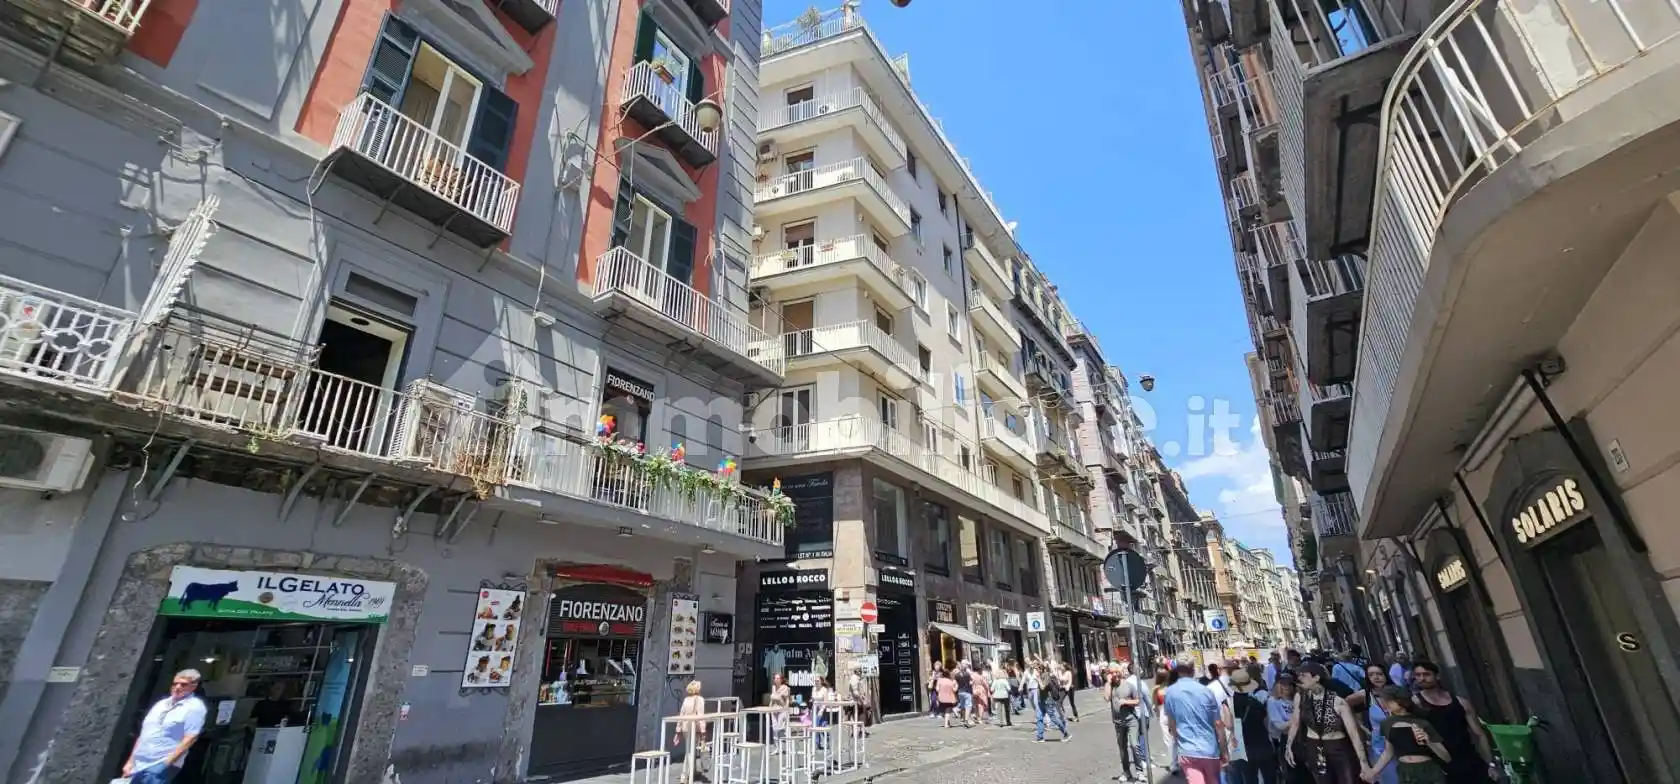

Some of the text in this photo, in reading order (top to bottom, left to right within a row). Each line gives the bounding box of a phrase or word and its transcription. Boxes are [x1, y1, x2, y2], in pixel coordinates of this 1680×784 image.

[607, 374, 655, 402] FIORENZANO
[1512, 478, 1585, 543] SOLARIS
[1437, 559, 1466, 590] SOLARIS
[559, 600, 643, 622] FIORENZANO
[1616, 632, 1641, 652] S
